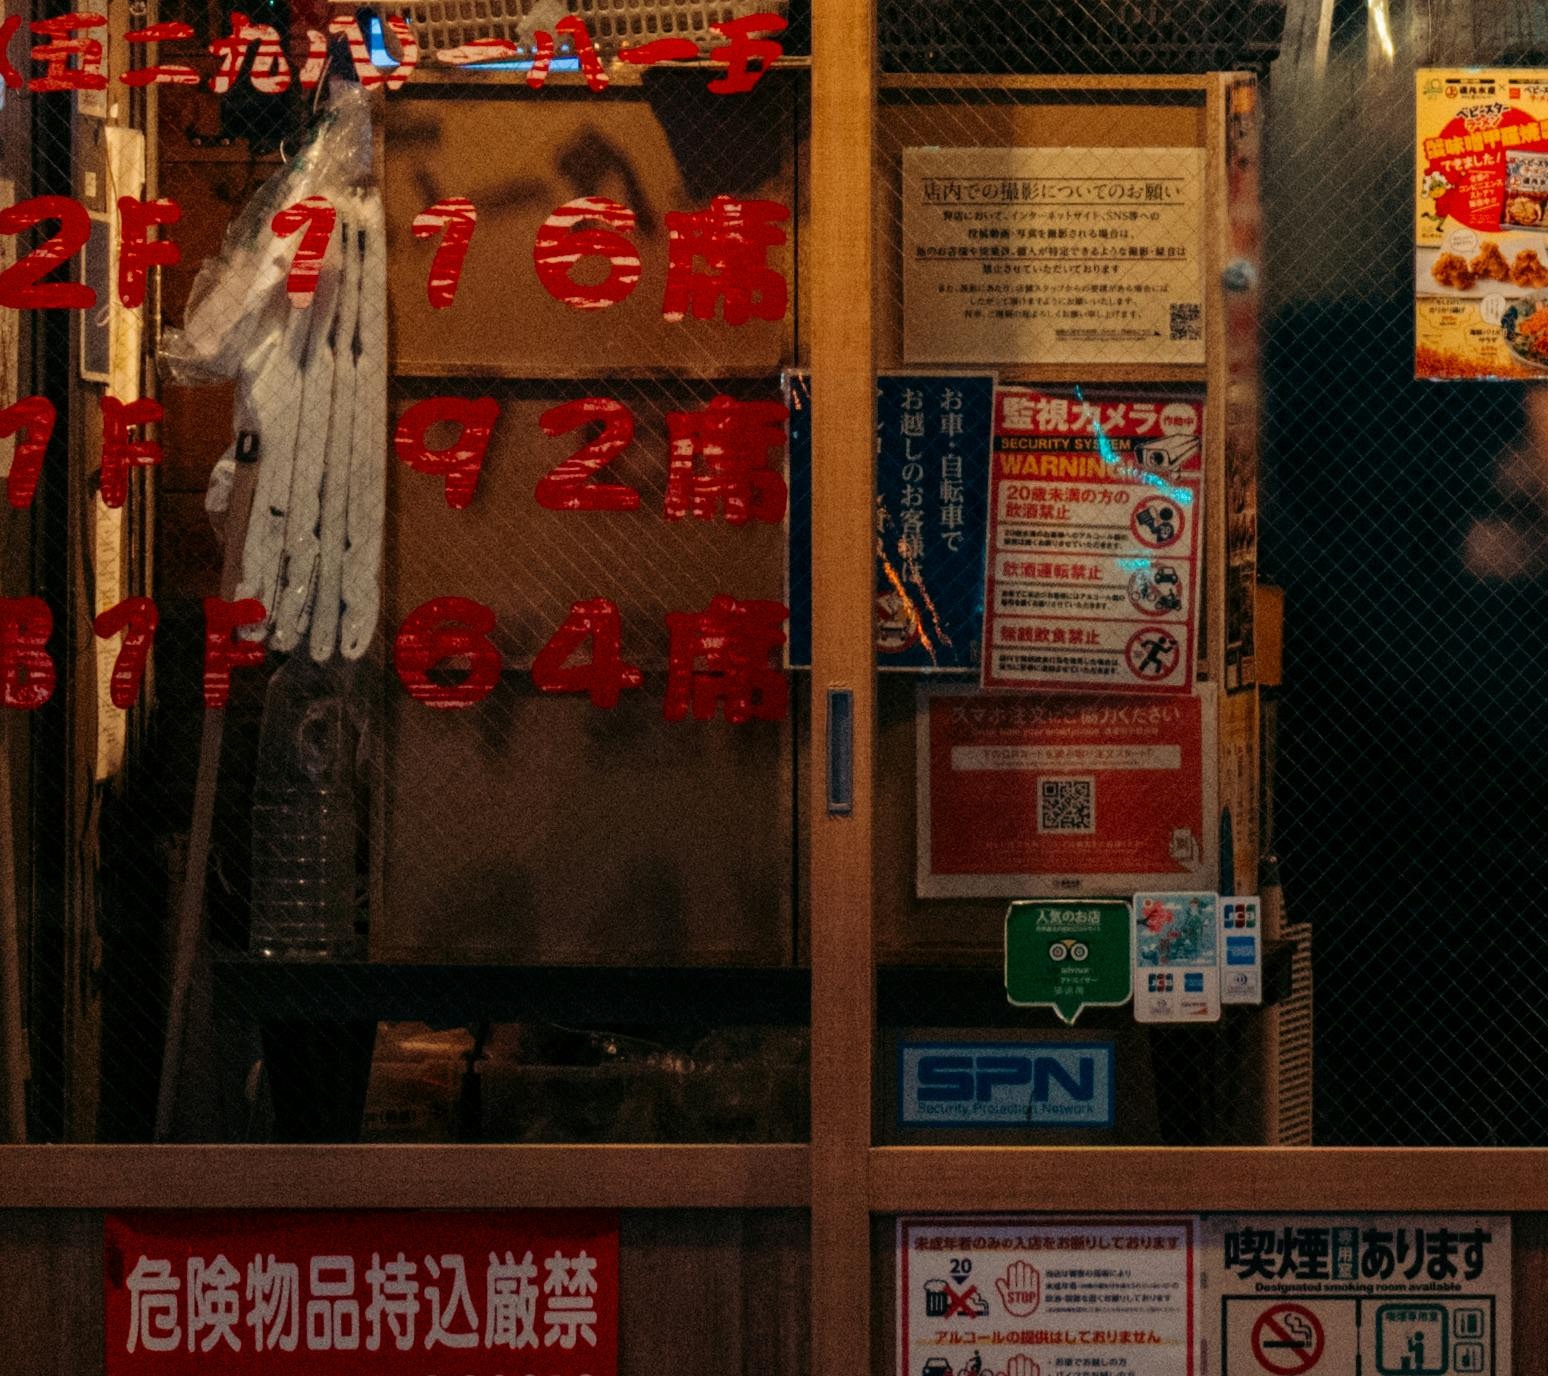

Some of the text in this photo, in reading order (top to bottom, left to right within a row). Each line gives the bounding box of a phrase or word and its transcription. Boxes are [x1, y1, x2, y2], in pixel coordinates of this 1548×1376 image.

[1001, 396, 1157, 434] 監視カメラ
[1000, 437, 1072, 450] SECURITY
[917, 1055, 1095, 1102] SPN
[918, 1102, 969, 1117] Security
[950, 1258, 972, 1273] 20
[1255, 1282, 1462, 1293] Designated room available
[126, 1251, 598, 1354] 危険物品持込厳禁
[1007, 1292, 1036, 1304] STOP
